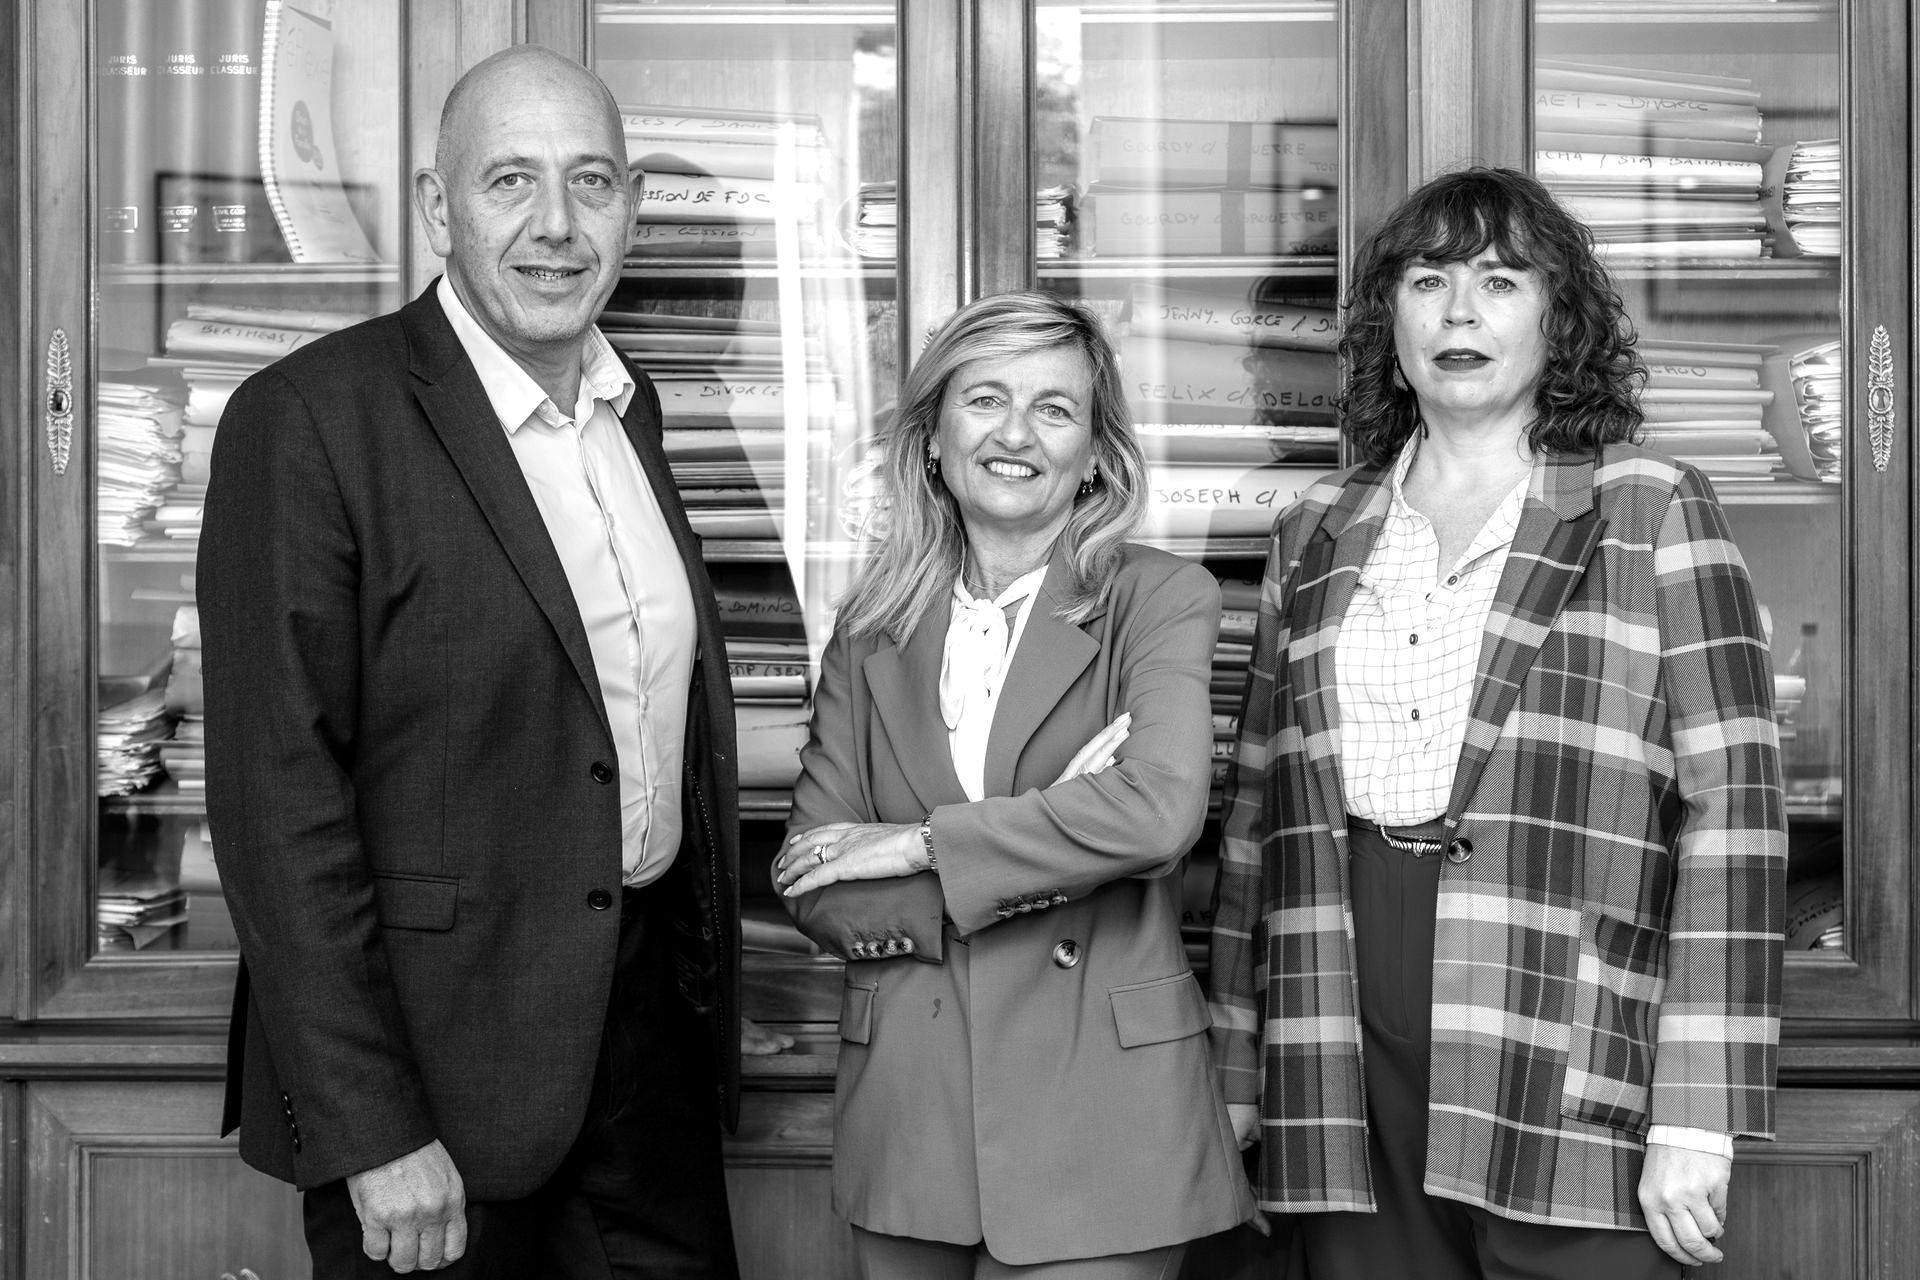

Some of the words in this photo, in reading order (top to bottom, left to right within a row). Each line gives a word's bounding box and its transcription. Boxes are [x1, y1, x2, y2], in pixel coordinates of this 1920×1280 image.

[108, 55, 137, 65] JURIS
[166, 54, 196, 64] JURIS
[218, 54, 249, 64] JURIS
[210, 65, 257, 75] CLASSEUR
[1154, 488, 1241, 504] JOSEPH
